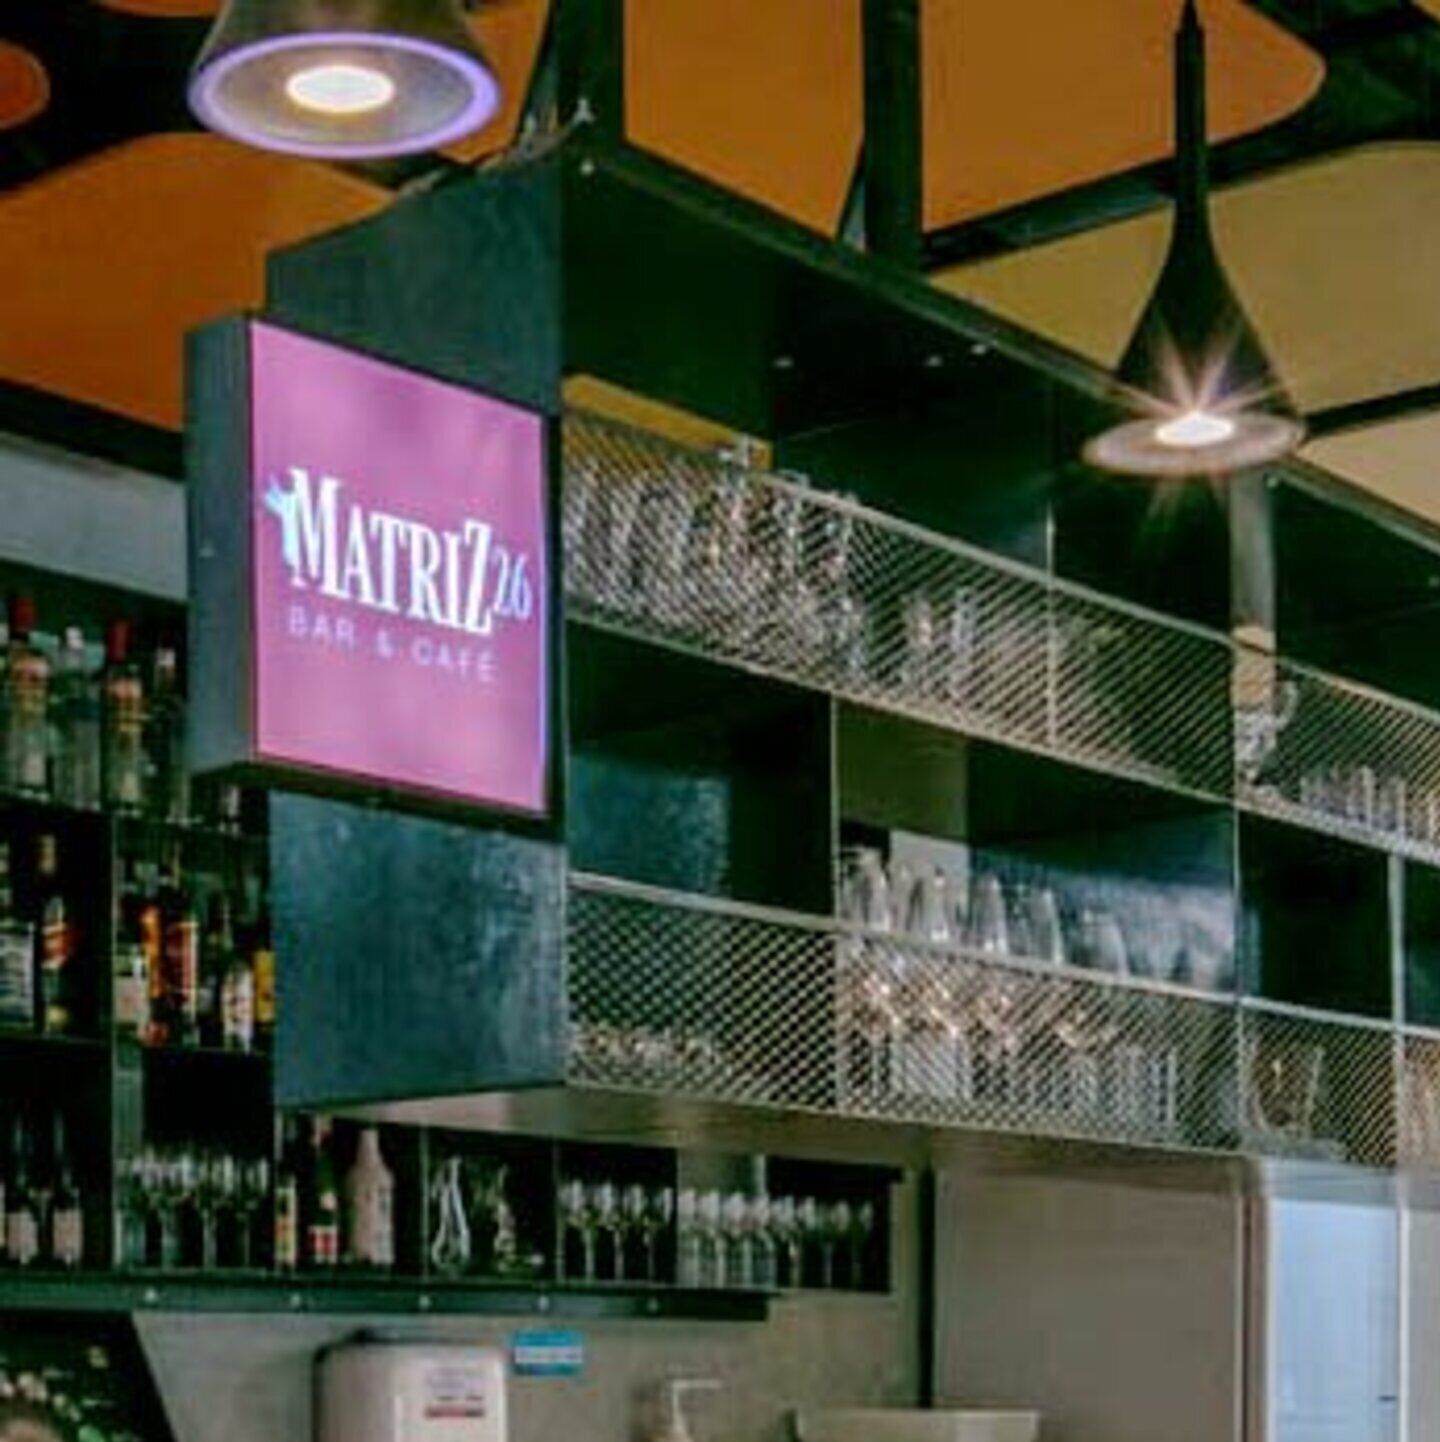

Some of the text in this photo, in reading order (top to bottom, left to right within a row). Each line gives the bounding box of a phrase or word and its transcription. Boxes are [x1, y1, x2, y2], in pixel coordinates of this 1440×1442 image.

[289, 467, 492, 636] MATRIZ
[289, 605, 355, 647] BAR
[377, 629, 393, 660] &
